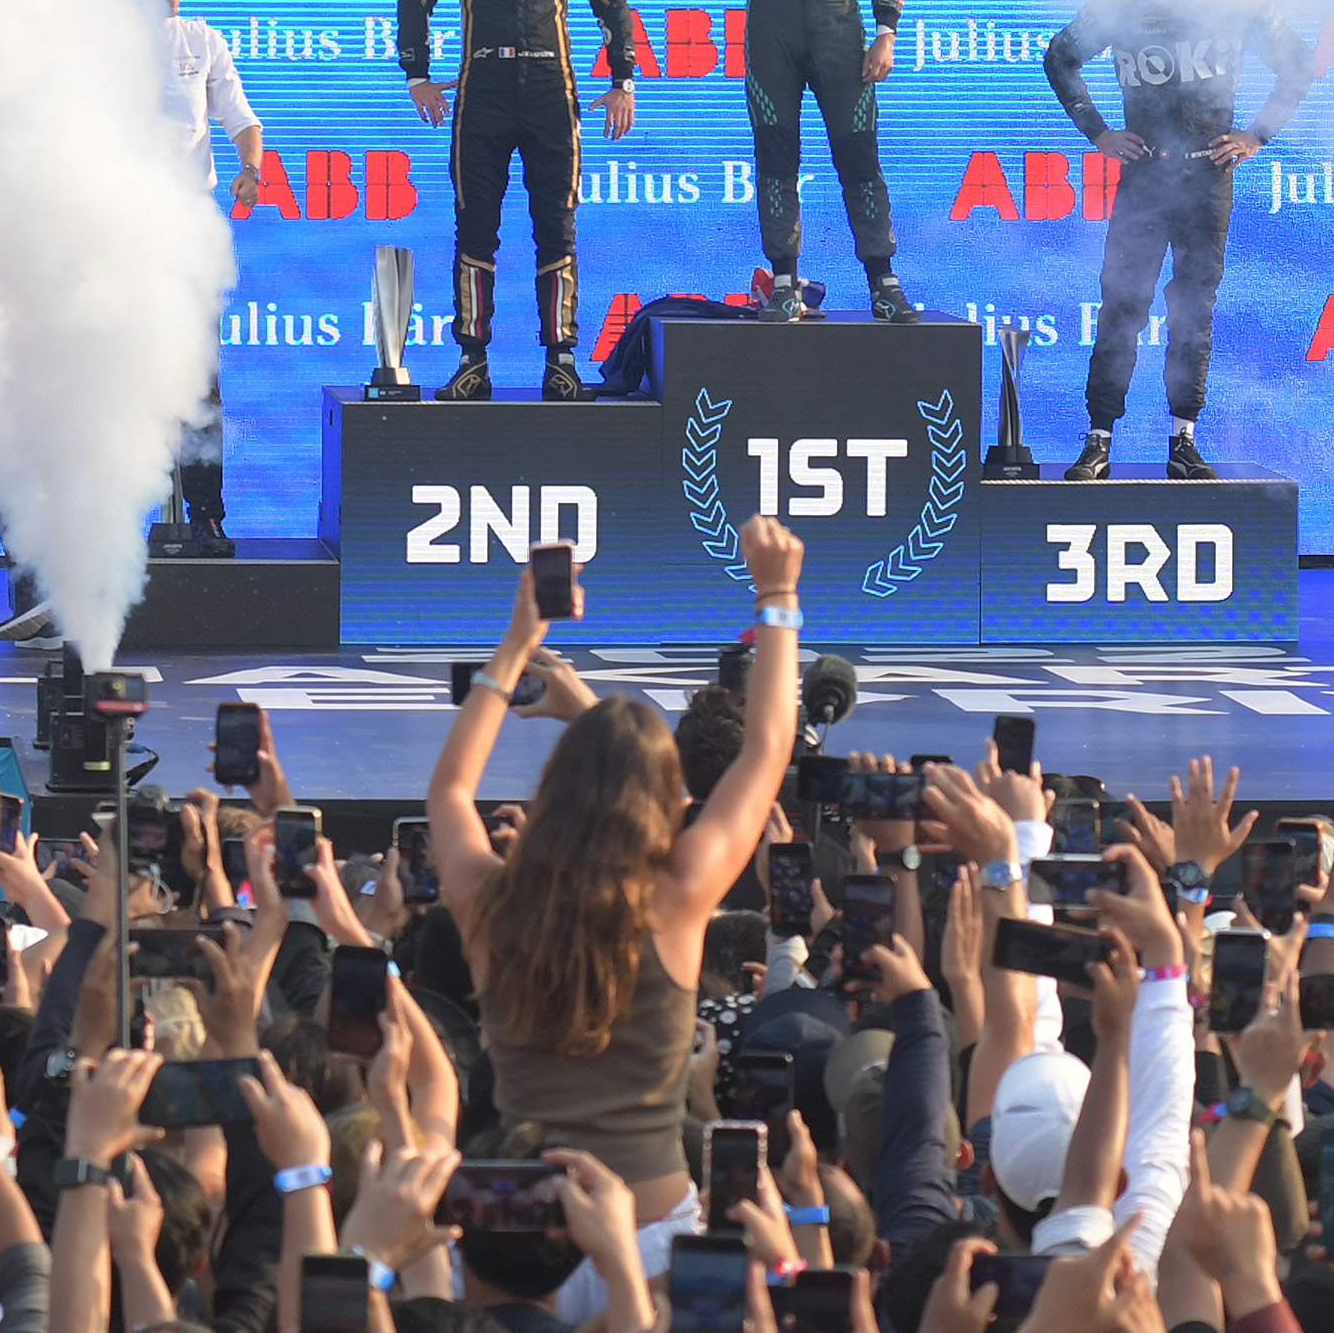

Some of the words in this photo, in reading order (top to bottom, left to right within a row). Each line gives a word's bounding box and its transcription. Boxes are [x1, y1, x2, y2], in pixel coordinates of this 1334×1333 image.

[230, 150, 418, 220] ABB
[405, 484, 598, 565] 2ND
[747, 438, 909, 517] 1ST
[1044, 522, 1235, 603] 3RD
